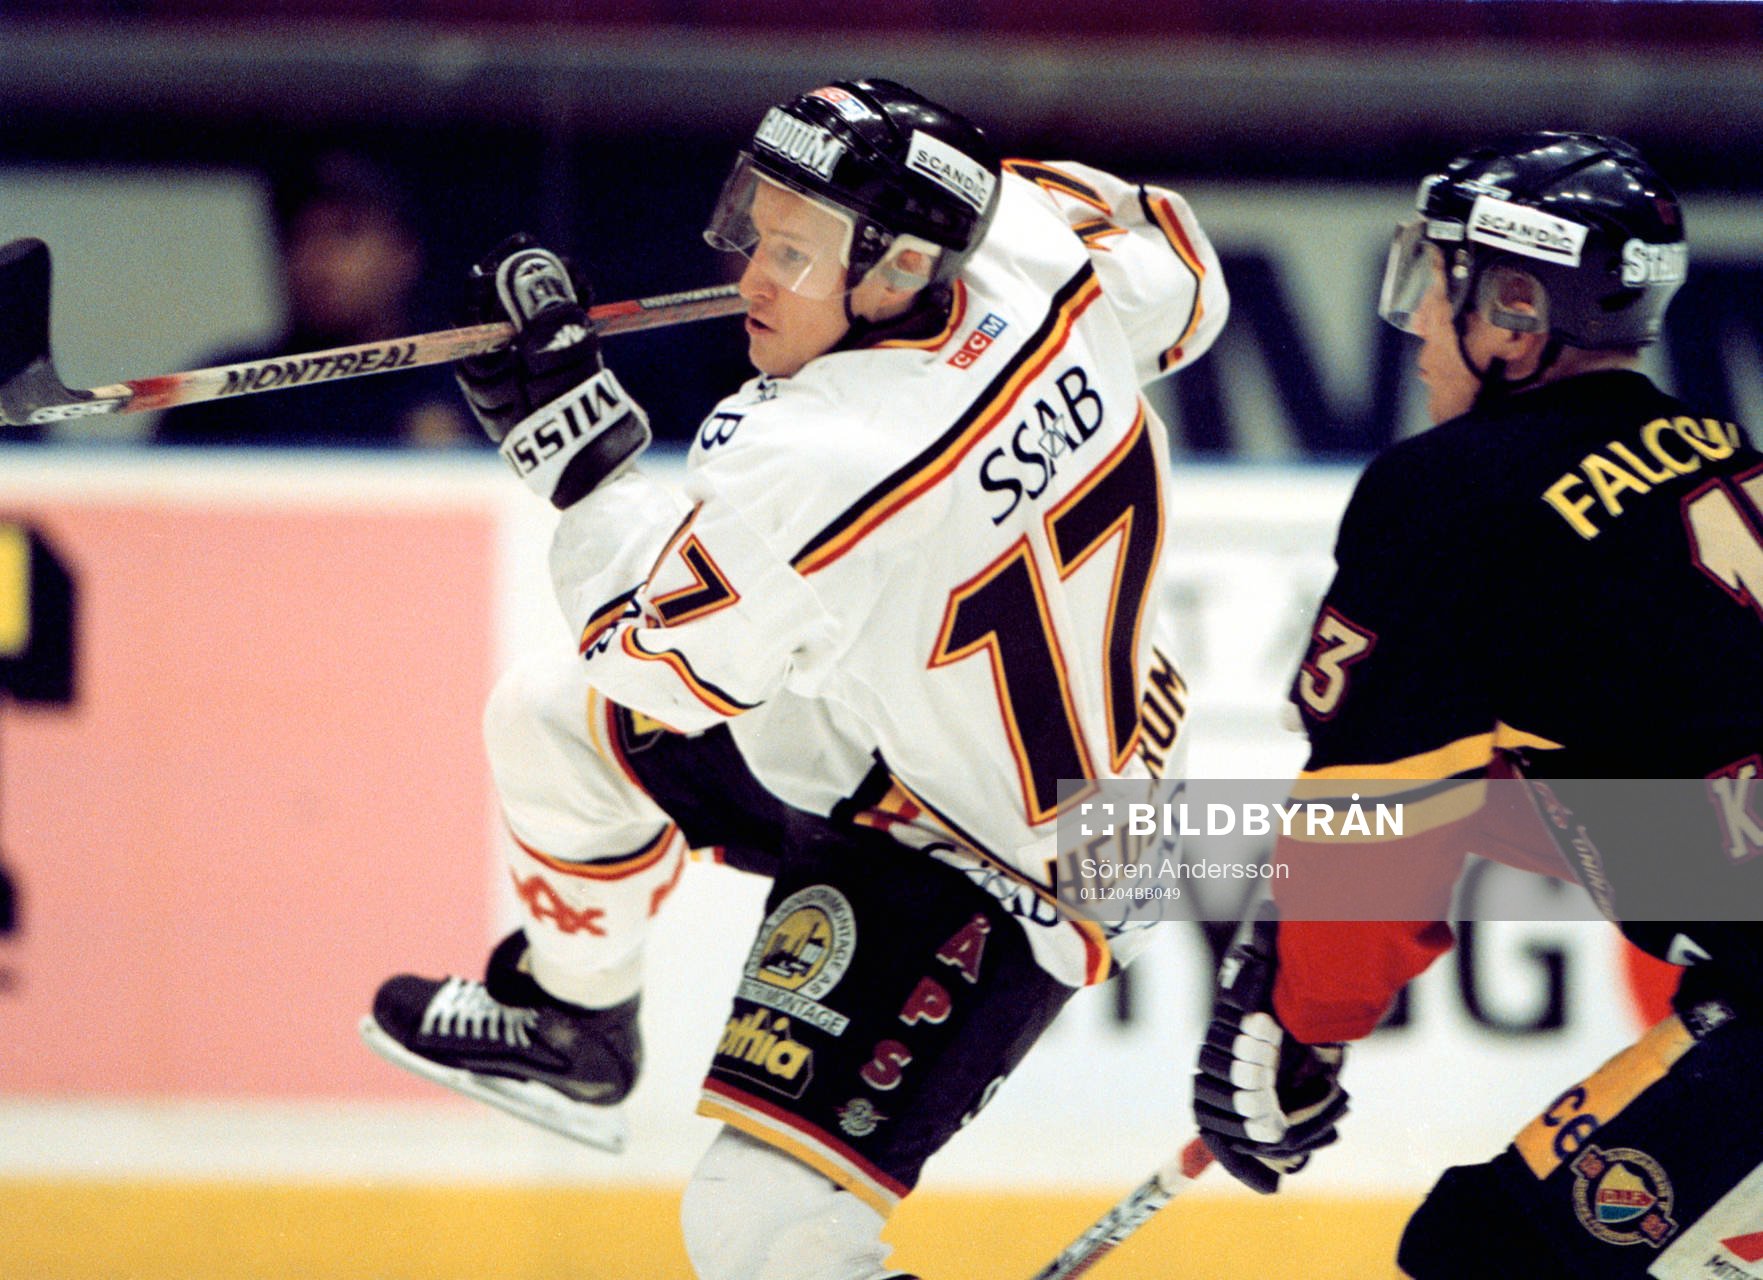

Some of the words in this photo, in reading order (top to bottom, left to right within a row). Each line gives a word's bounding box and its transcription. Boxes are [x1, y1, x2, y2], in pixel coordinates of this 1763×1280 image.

[916, 149, 990, 204] SCANDIC
[1476, 212, 1576, 251] SCANDIC
[219, 342, 419, 396] MONTREAL
[946, 313, 1009, 370] CCM
[979, 366, 1104, 526] SSAB
[645, 531, 742, 629] 7
[926, 395, 1167, 827] 17
